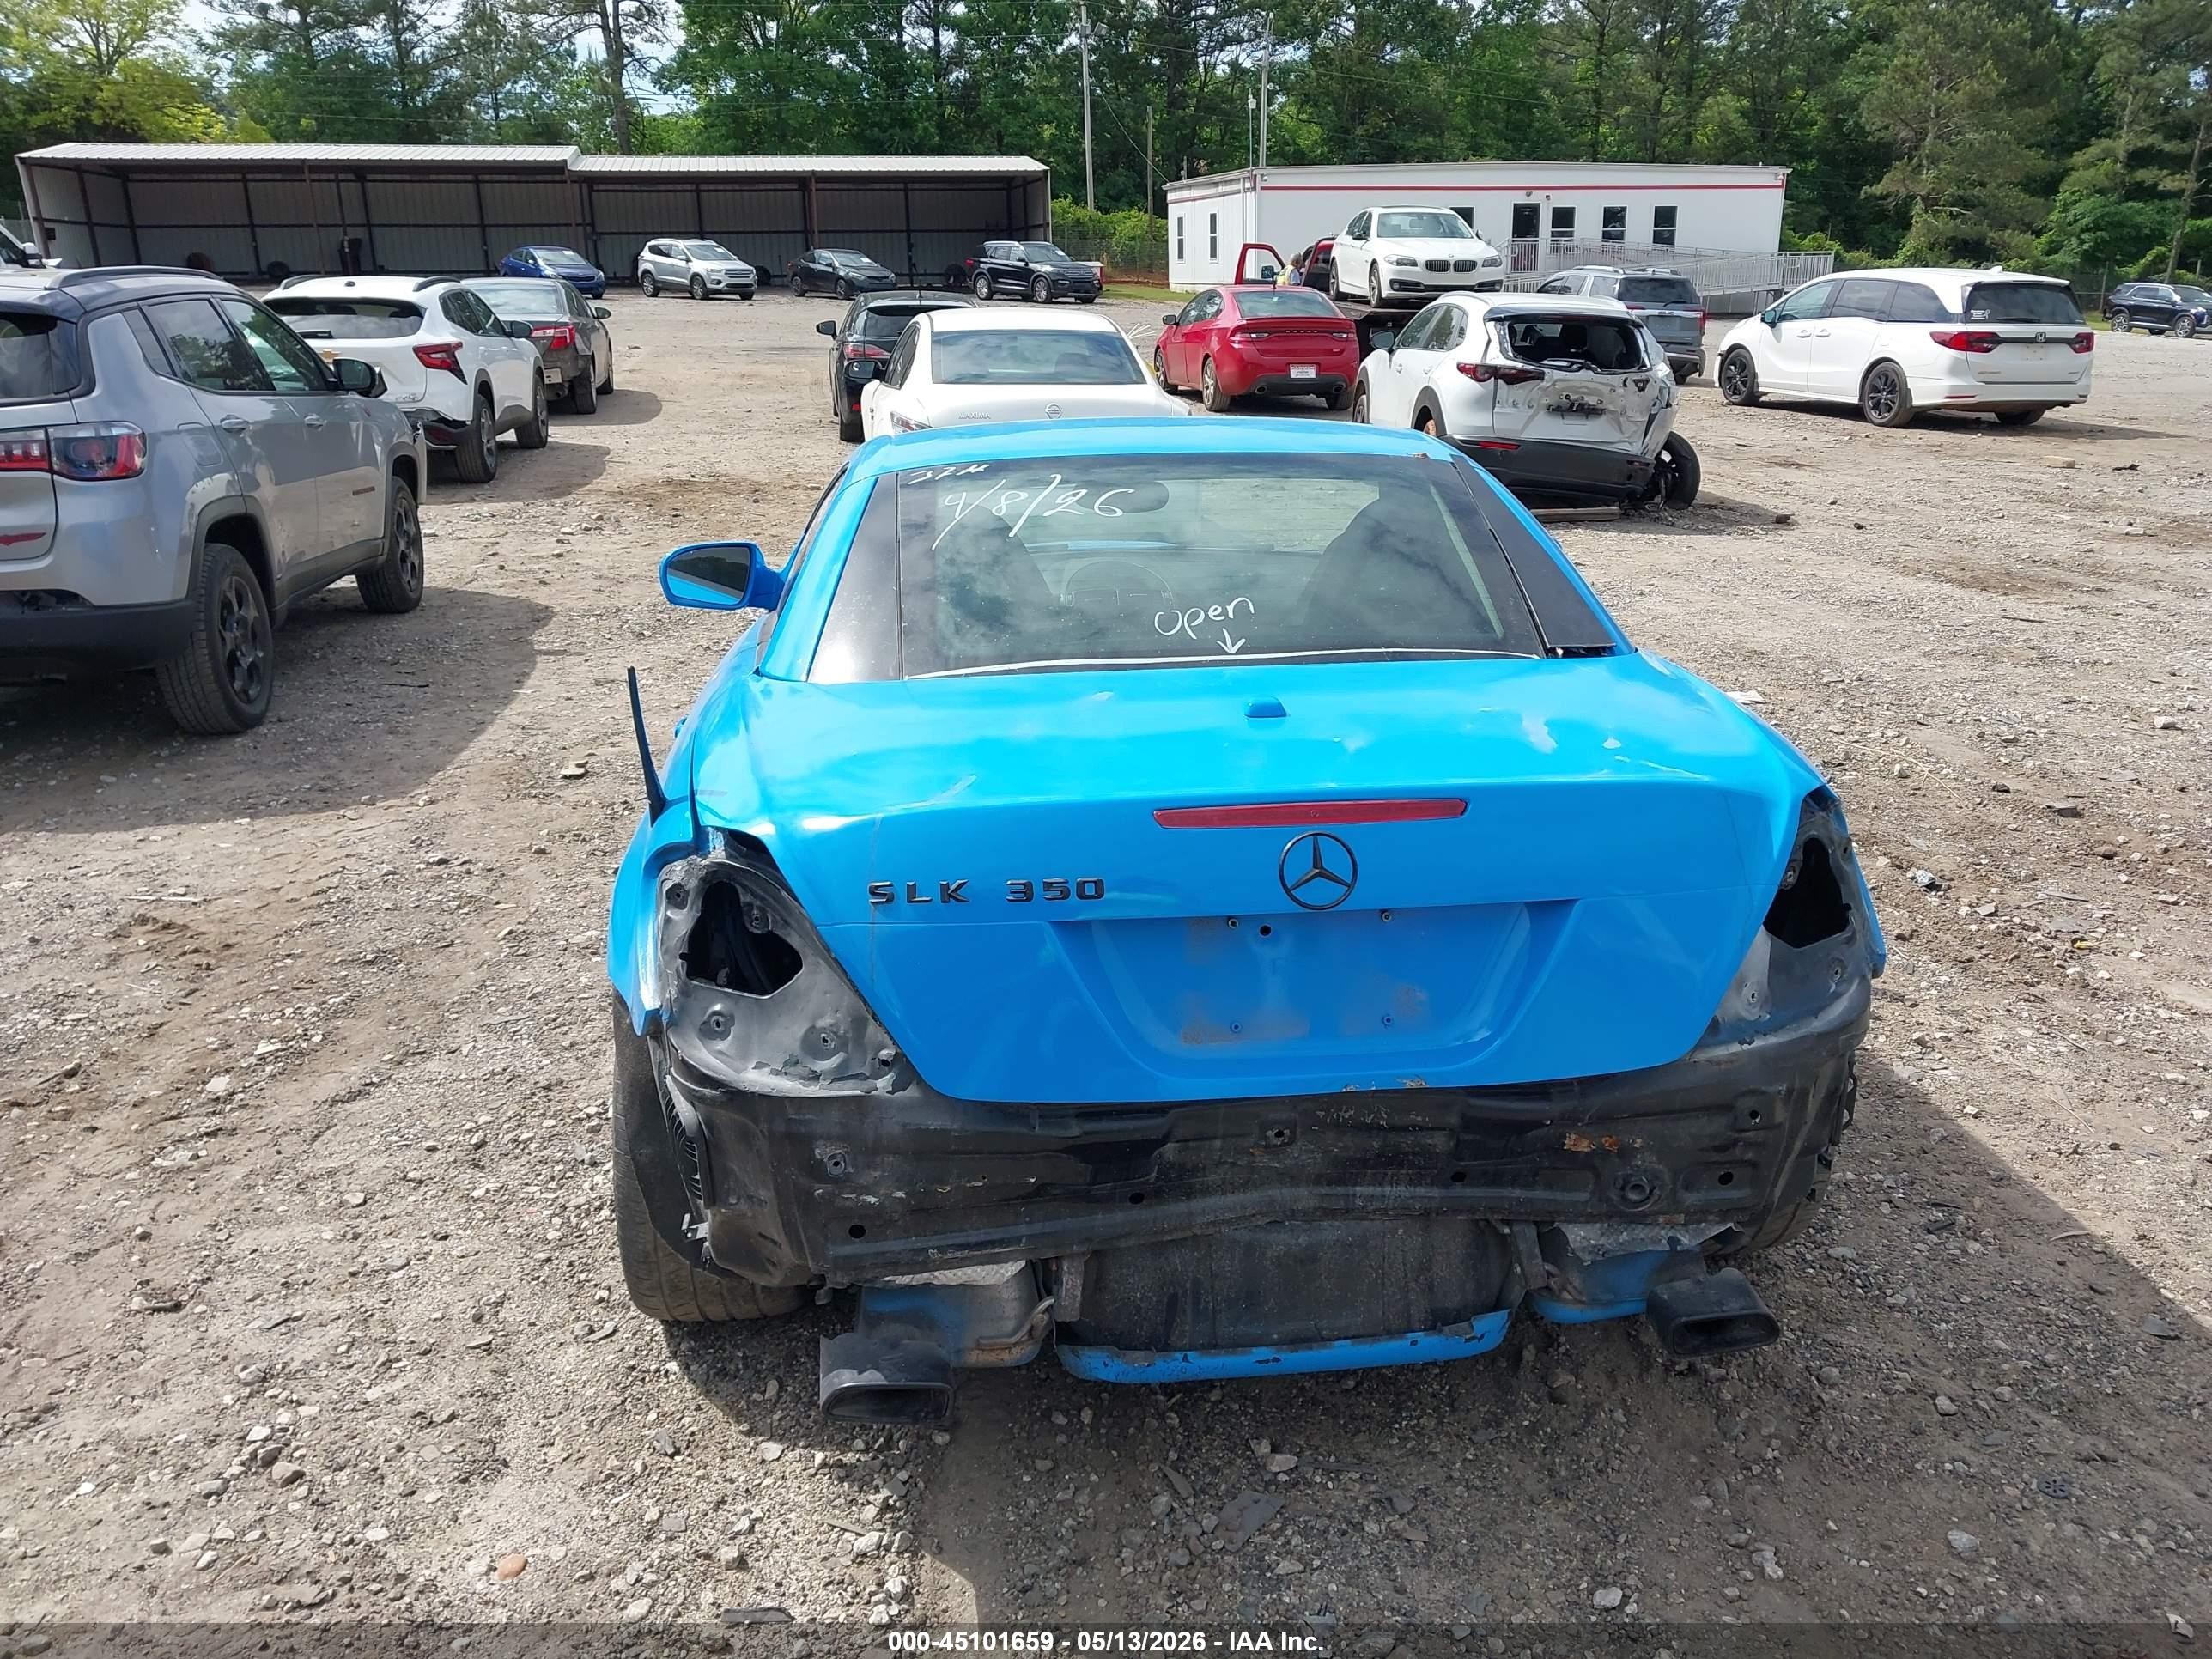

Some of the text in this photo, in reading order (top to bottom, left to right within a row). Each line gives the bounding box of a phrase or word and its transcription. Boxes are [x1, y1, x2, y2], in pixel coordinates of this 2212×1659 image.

[931, 473, 1136, 551] 4/8/26
[868, 878, 1105, 904] SLK 350
